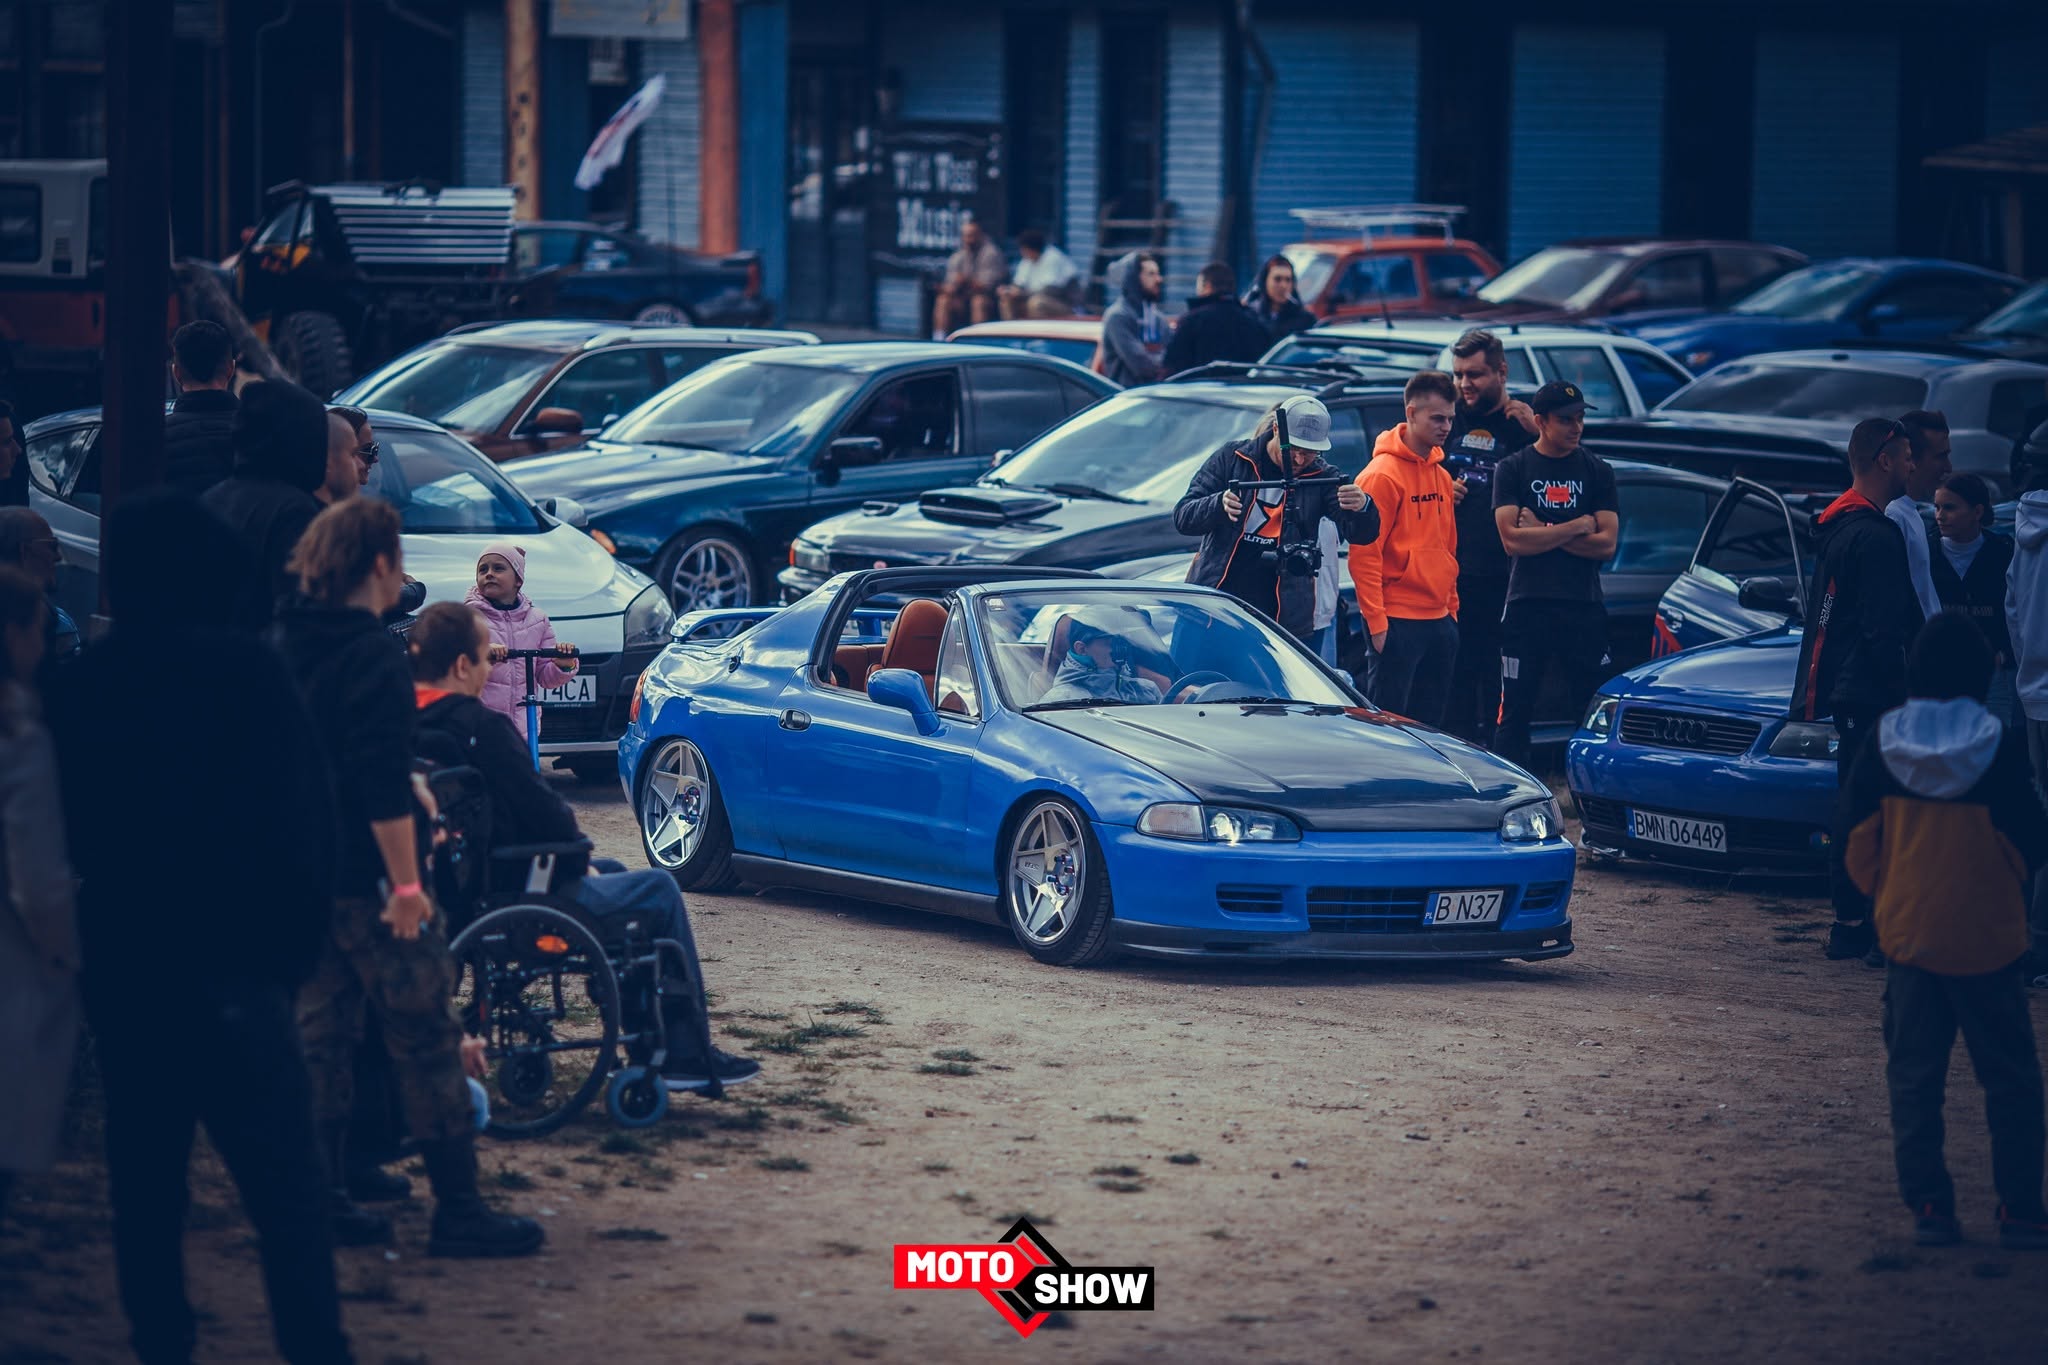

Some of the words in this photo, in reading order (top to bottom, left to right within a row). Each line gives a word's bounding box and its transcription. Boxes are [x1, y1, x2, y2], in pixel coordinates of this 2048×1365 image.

[1635, 813, 1666, 840] BMN
[1669, 819, 1724, 849] 06449
[1435, 896, 1452, 920] B
[1456, 894, 1500, 920] N37
